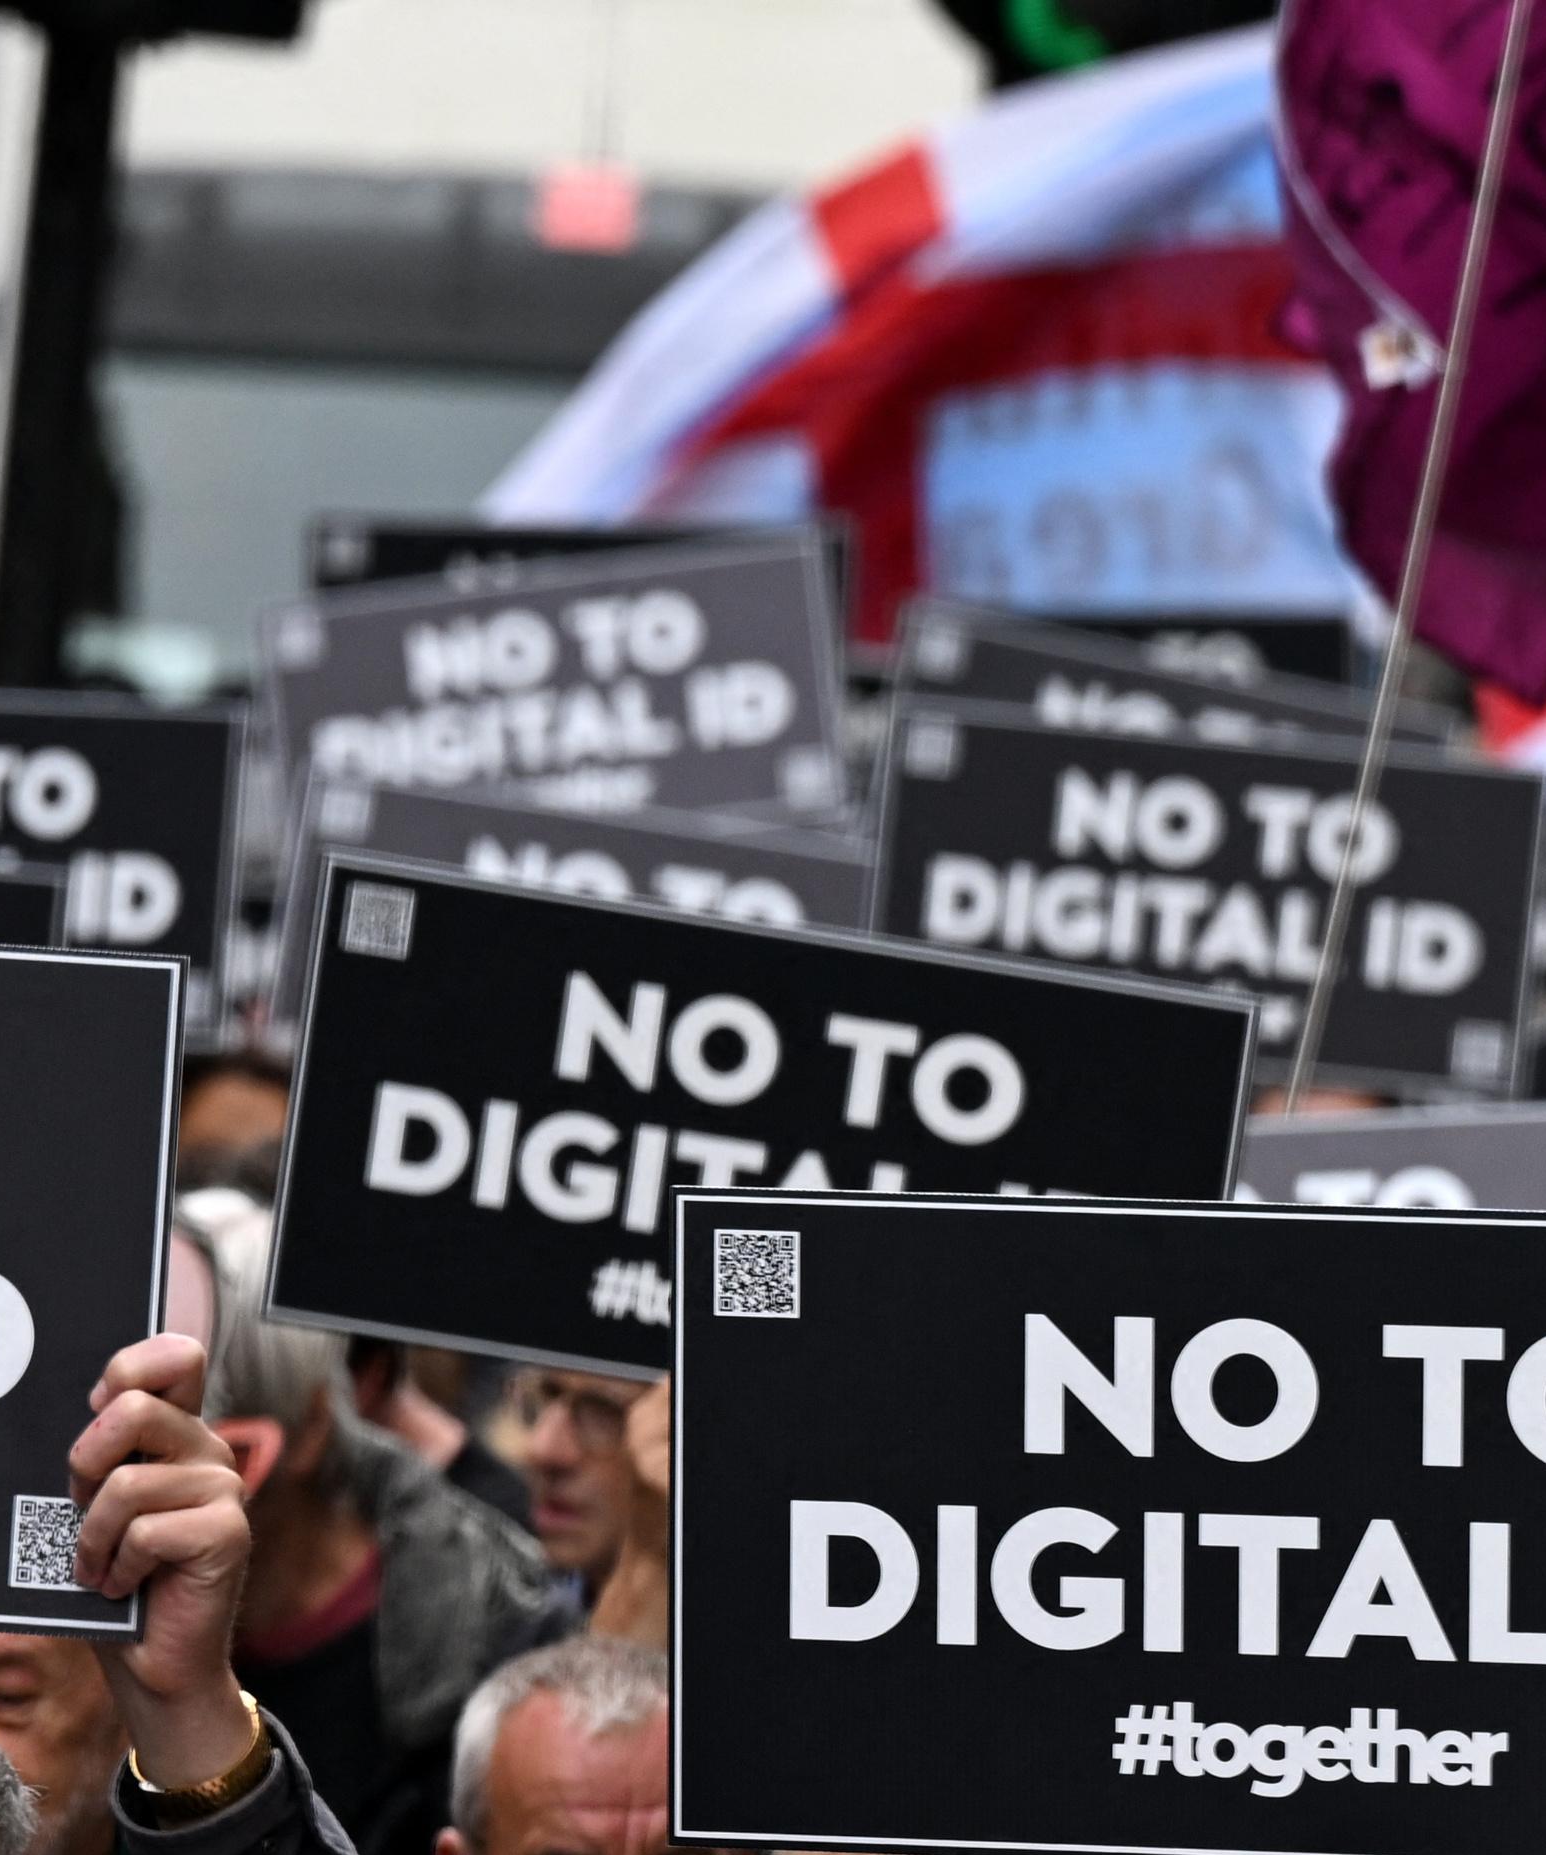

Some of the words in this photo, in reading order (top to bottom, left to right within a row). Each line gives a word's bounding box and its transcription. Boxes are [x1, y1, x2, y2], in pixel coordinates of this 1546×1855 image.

[405, 609, 557, 701] NO
[562, 589, 706, 681] TO
[685, 660, 796, 750] ID
[1054, 765, 1223, 869] NO
[1243, 782, 1401, 887] TO
[66, 849, 183, 946] ID
[921, 851, 1325, 980] DIGITAL
[1364, 897, 1485, 995] ID
[555, 970, 780, 1106] NO
[829, 1013, 1025, 1146] TO
[1023, 1312, 1321, 1462] NO
[1112, 1701, 1509, 1799] #together
